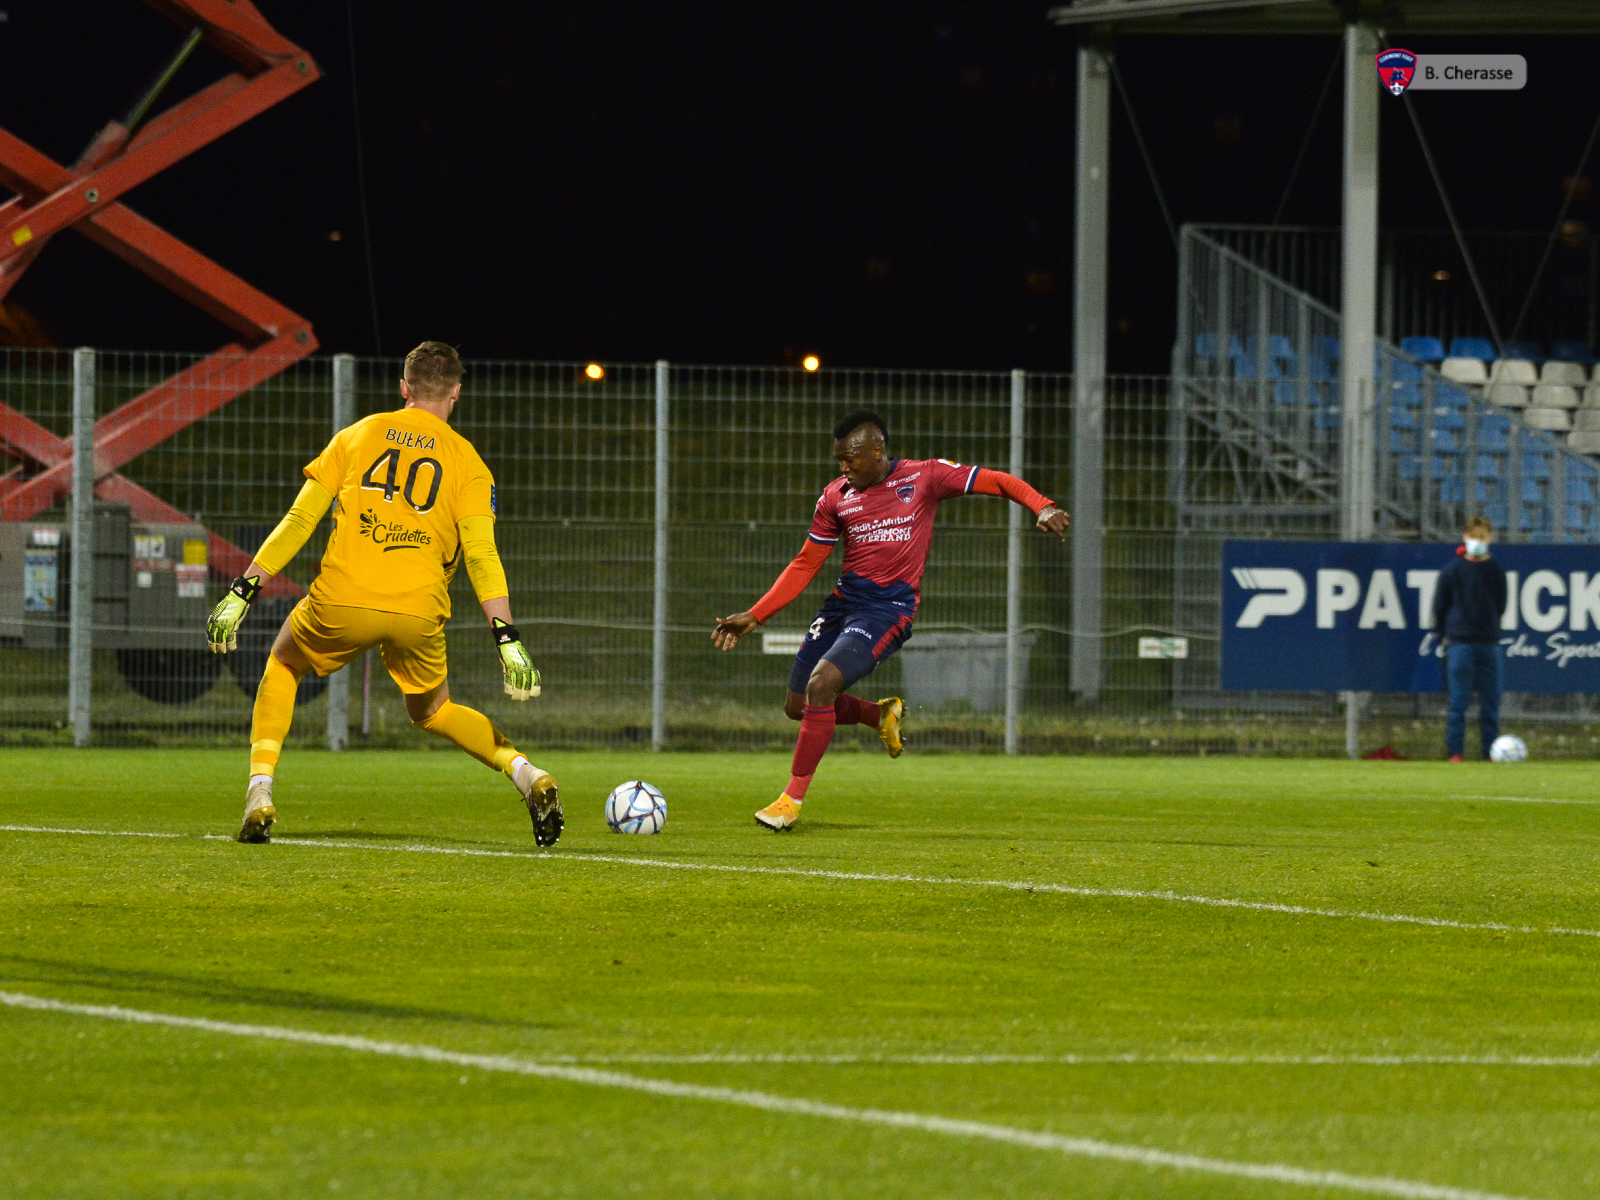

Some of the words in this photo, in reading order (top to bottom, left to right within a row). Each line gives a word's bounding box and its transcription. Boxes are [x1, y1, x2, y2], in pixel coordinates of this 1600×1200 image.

[385, 428, 436, 450] BUŁKA
[361, 448, 443, 514] 40
[389, 522, 403, 531] Les
[882, 513, 915, 527] Mutuel
[372, 523, 432, 545] Crudettes
[1316, 569, 1600, 632] PATICK
[1545, 632, 1600, 668] Spor
